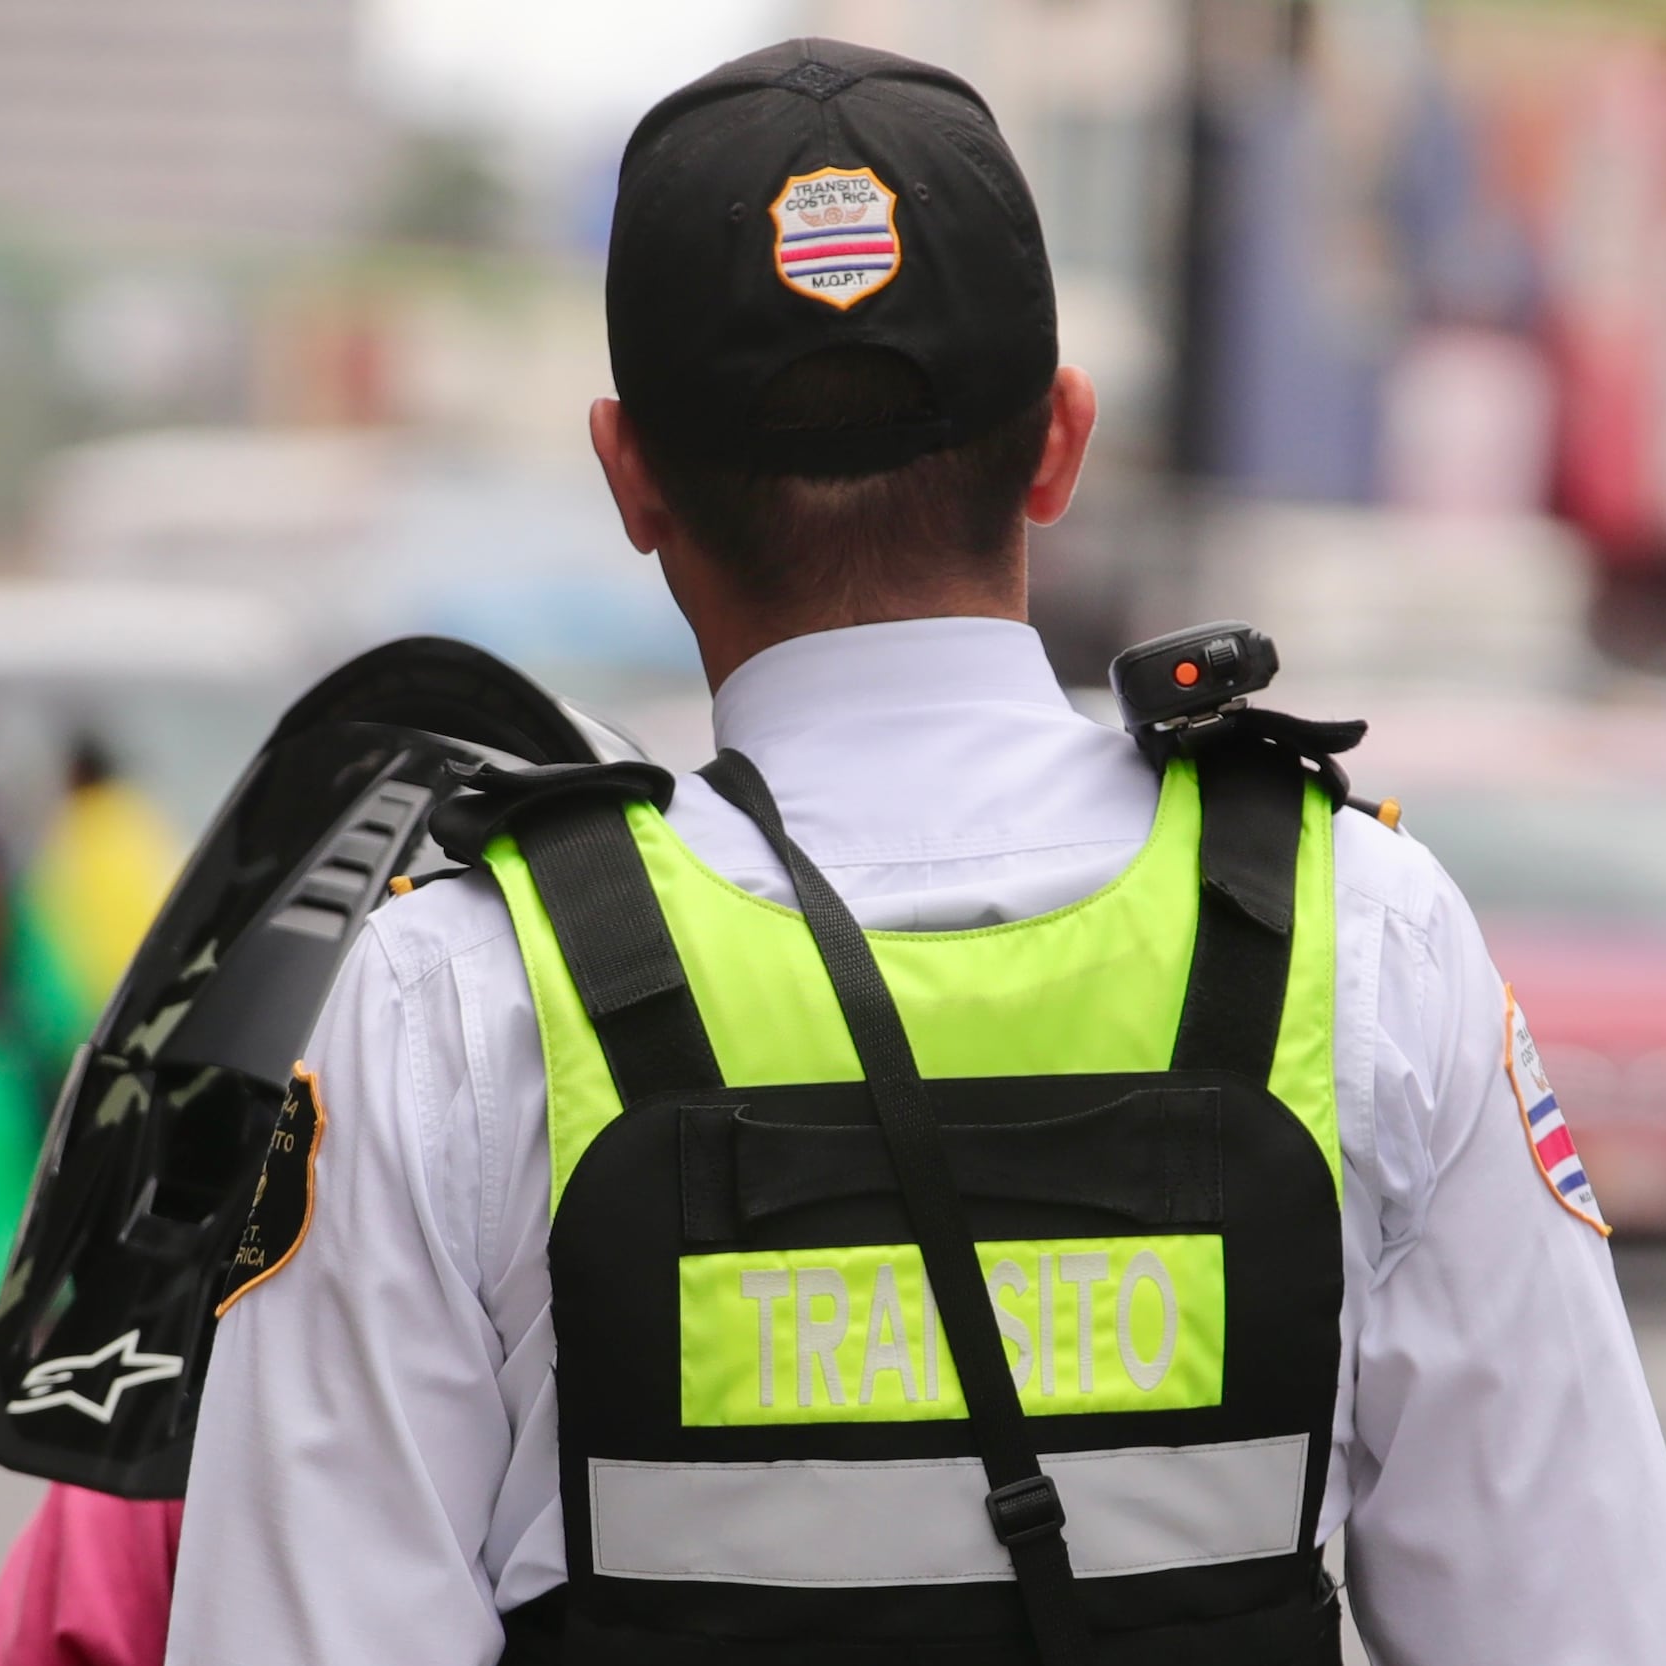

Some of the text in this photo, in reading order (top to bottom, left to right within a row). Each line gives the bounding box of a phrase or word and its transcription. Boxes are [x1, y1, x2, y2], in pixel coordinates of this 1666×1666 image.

[794, 178, 871, 197] TRANSITO
[786, 191, 879, 211] COSTA RICA
